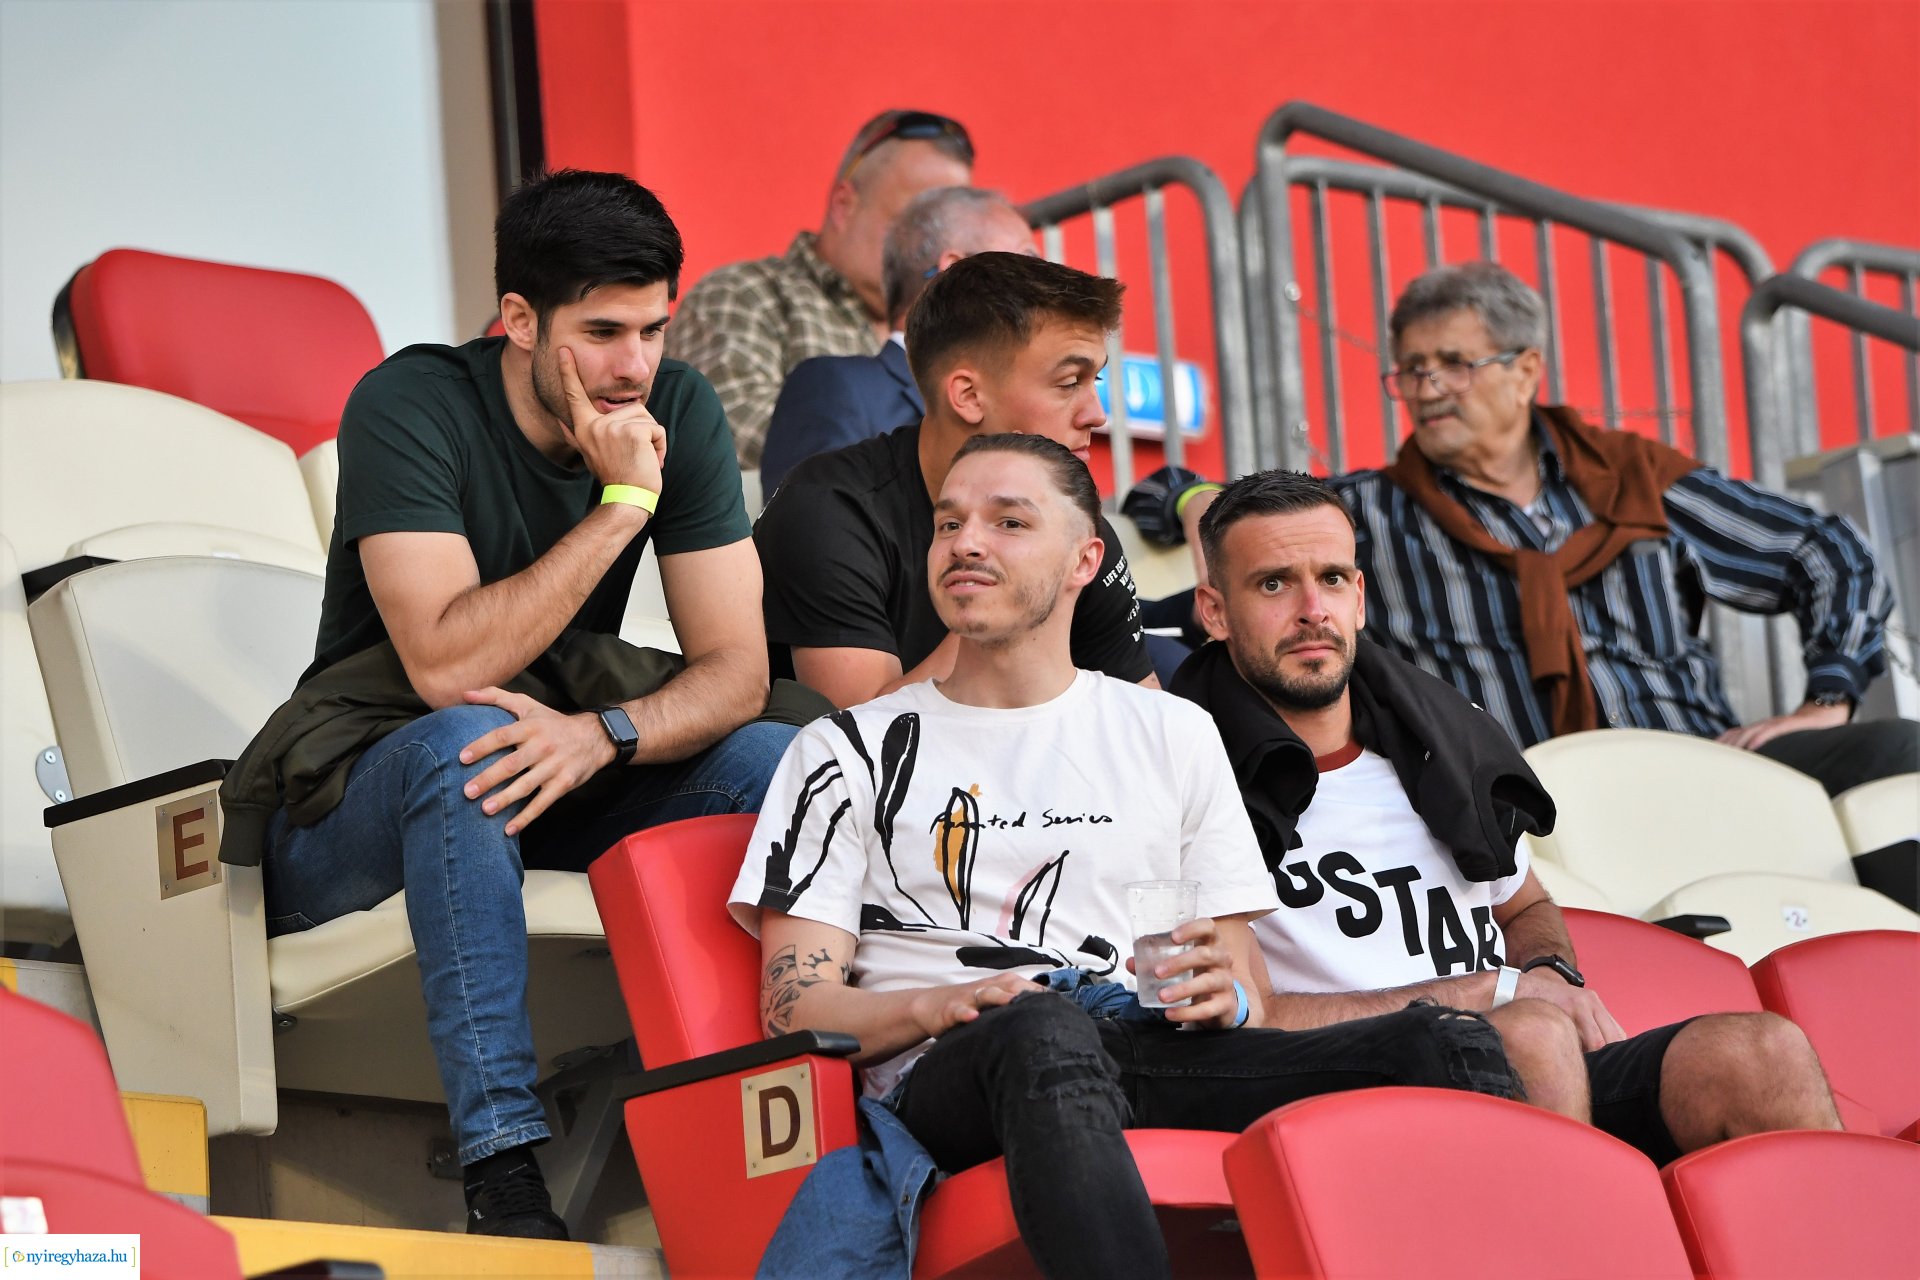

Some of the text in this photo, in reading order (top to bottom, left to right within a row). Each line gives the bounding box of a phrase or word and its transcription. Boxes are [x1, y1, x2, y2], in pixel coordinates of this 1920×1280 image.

[1102, 569, 1119, 587] LIFE
[173, 807, 209, 880] E
[1791, 911, 1803, 928] 2
[758, 1085, 801, 1159] D
